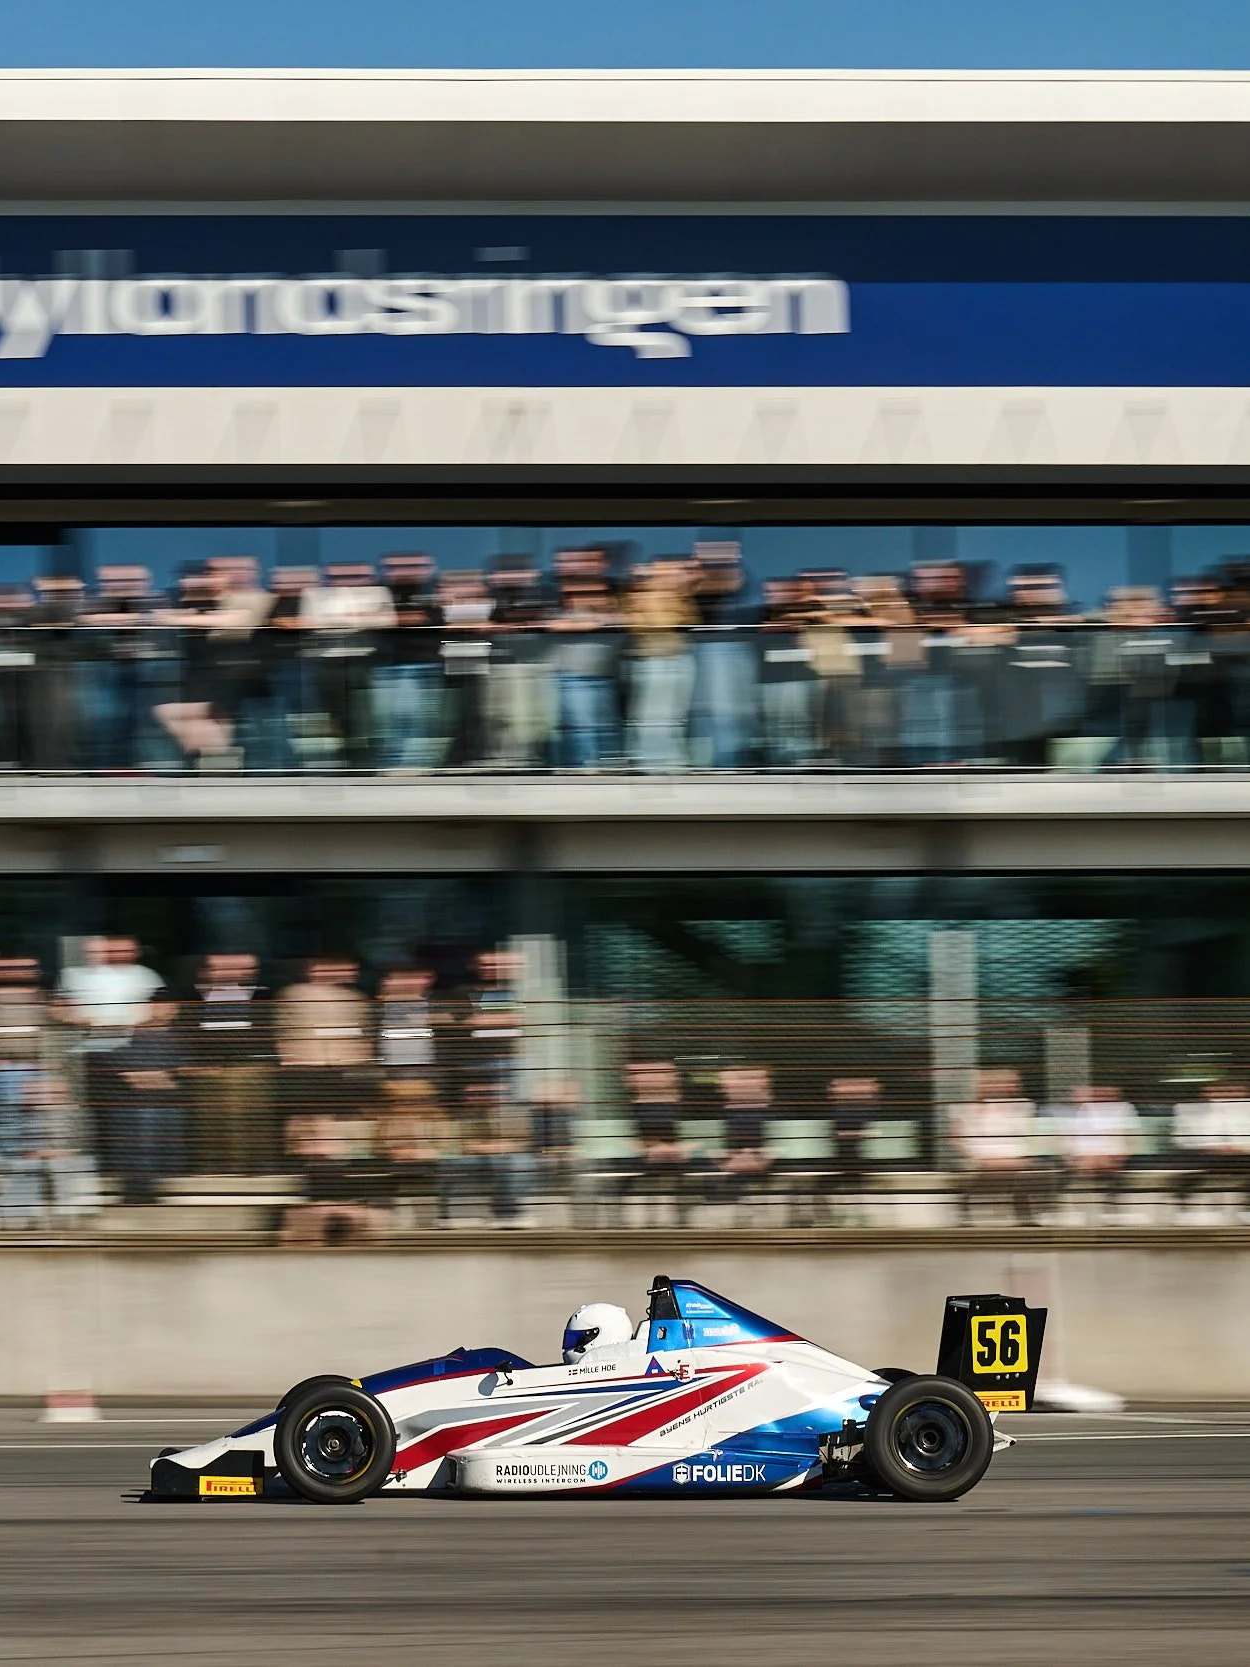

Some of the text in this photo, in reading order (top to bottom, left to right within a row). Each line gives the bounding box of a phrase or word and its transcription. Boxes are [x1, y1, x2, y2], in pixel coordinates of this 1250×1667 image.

[976, 1320, 1020, 1367] 56
[579, 1365, 599, 1374] MILLE
[693, 1386, 746, 1420] HURTIGSTE
[978, 1396, 1020, 1407] RELLI
[496, 1464, 587, 1476] RADIOUDLEJNING
[692, 1464, 766, 1482] FOLIEDK
